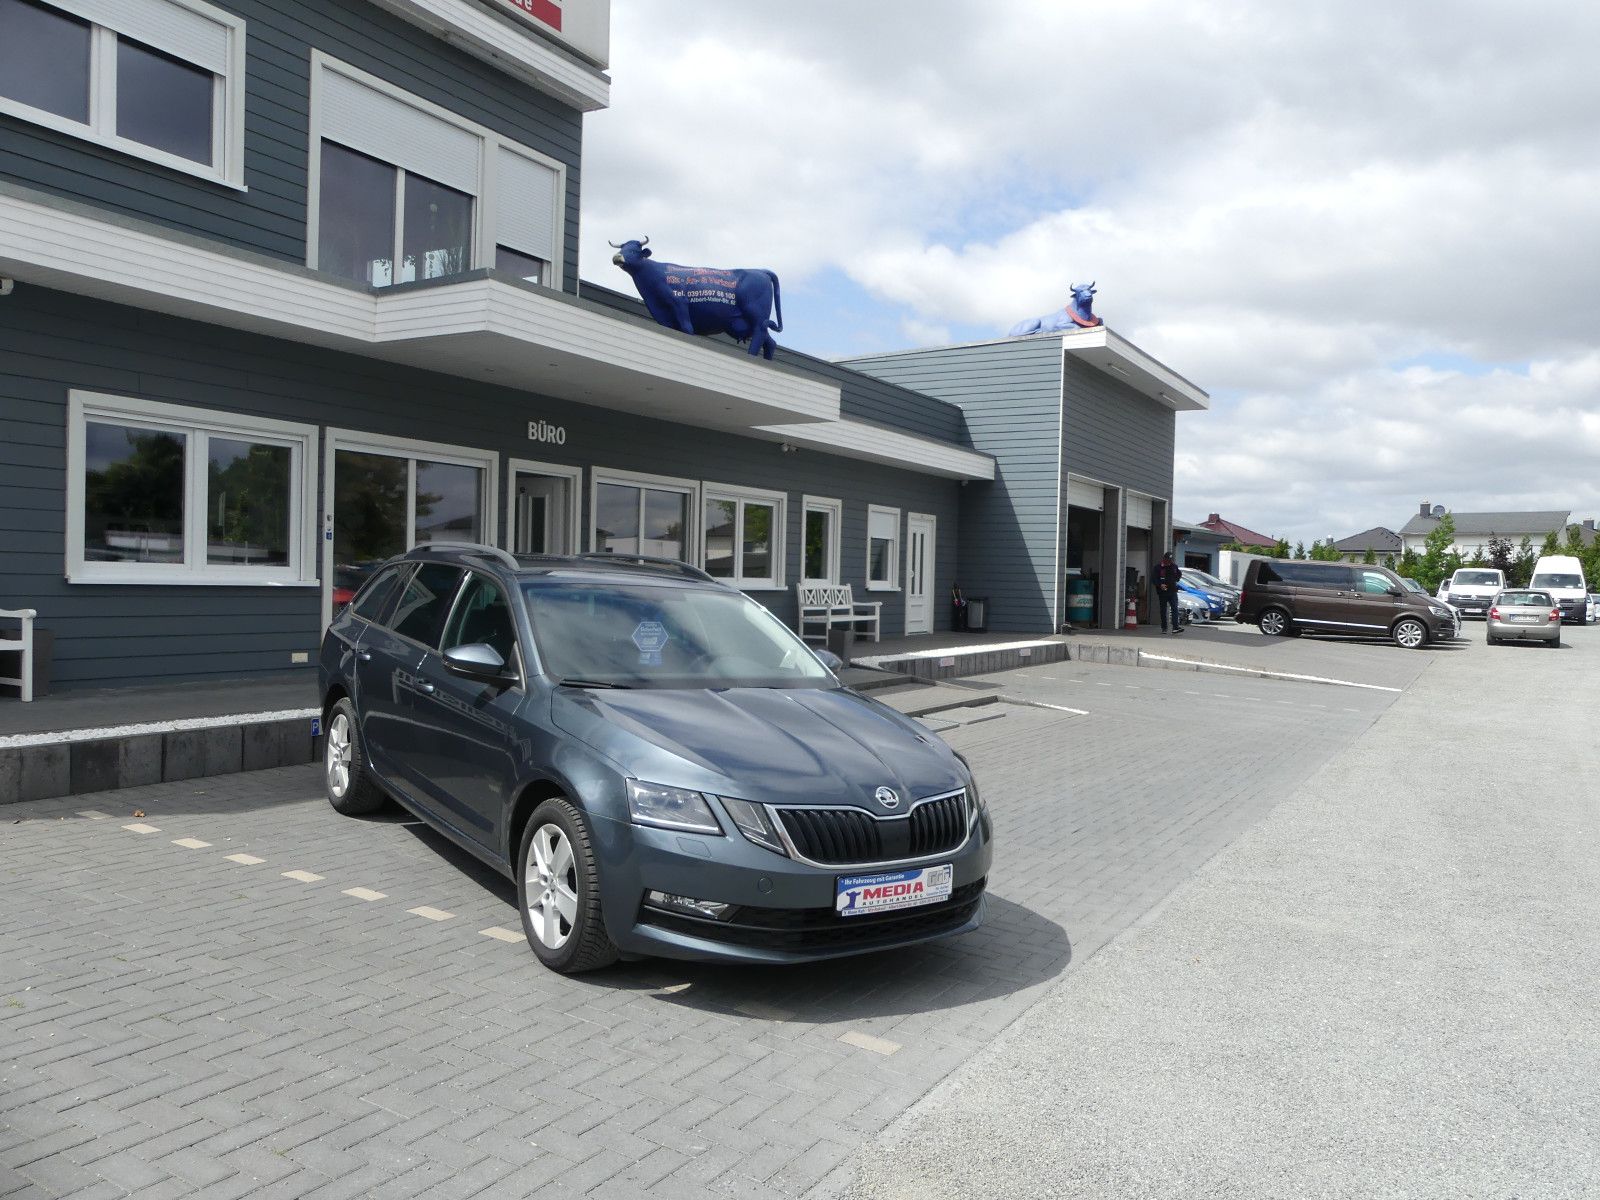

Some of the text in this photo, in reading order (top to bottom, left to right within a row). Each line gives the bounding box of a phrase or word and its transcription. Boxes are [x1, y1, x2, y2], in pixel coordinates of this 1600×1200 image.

[527, 419, 566, 445] BÜRO
[862, 881, 924, 900] MEDIA
[862, 894, 923, 906] AUTOHANDEL
